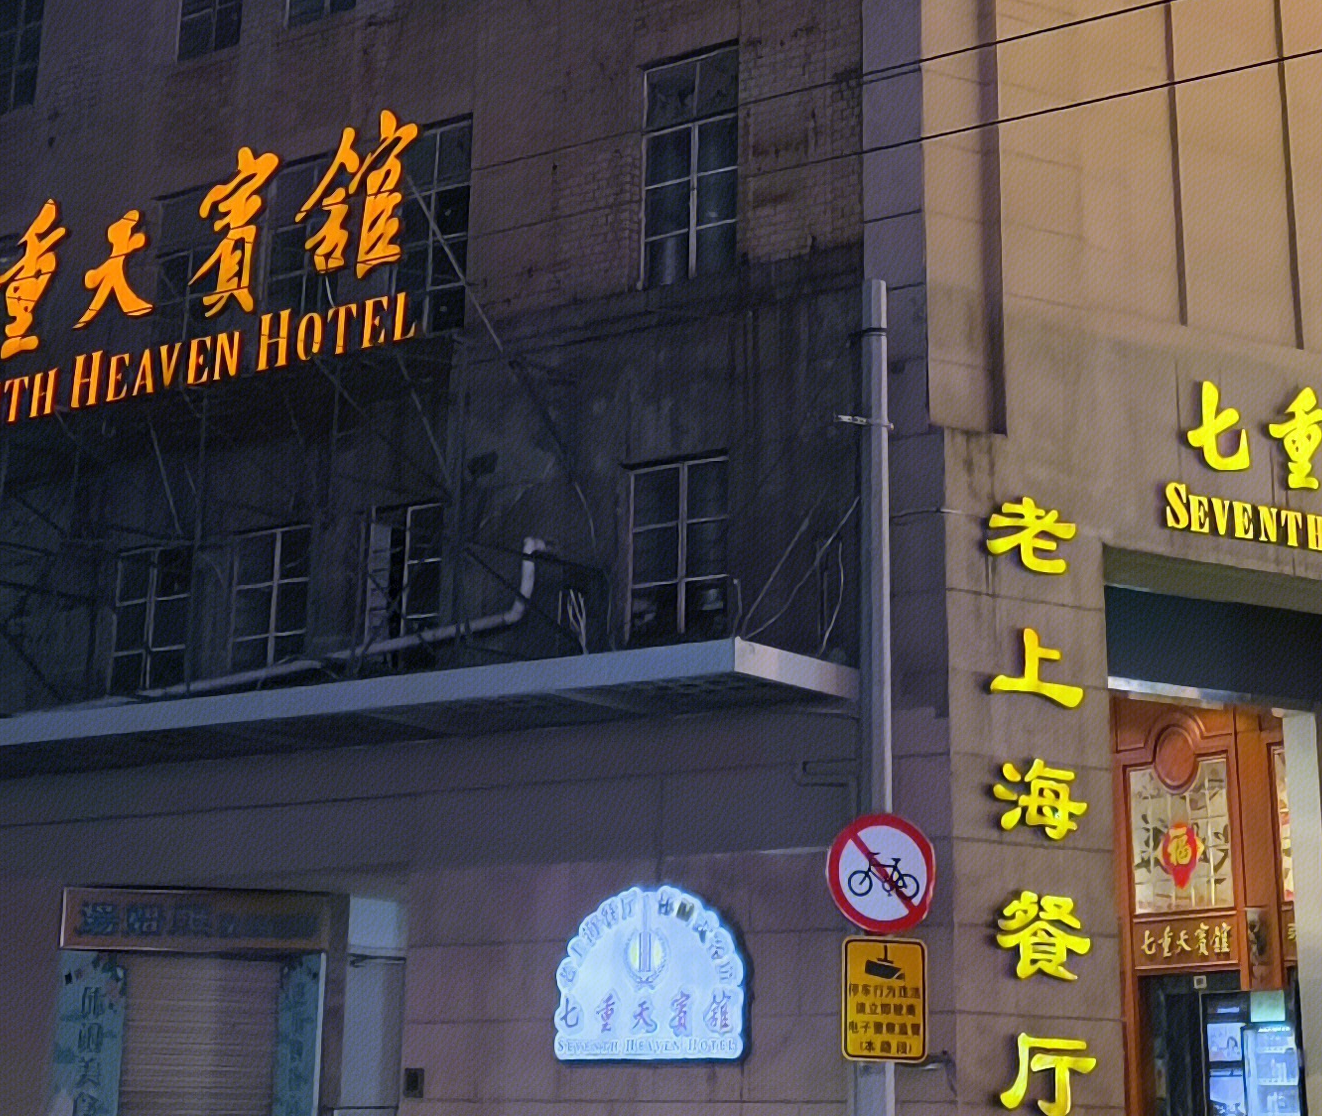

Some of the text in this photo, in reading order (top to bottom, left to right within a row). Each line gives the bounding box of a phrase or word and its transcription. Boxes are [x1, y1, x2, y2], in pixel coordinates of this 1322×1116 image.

[69, 330, 242, 409] HEAVEN
[256, 291, 415, 372] HOTEL
[986, 496, 1097, 1116] 老上海餐厅
